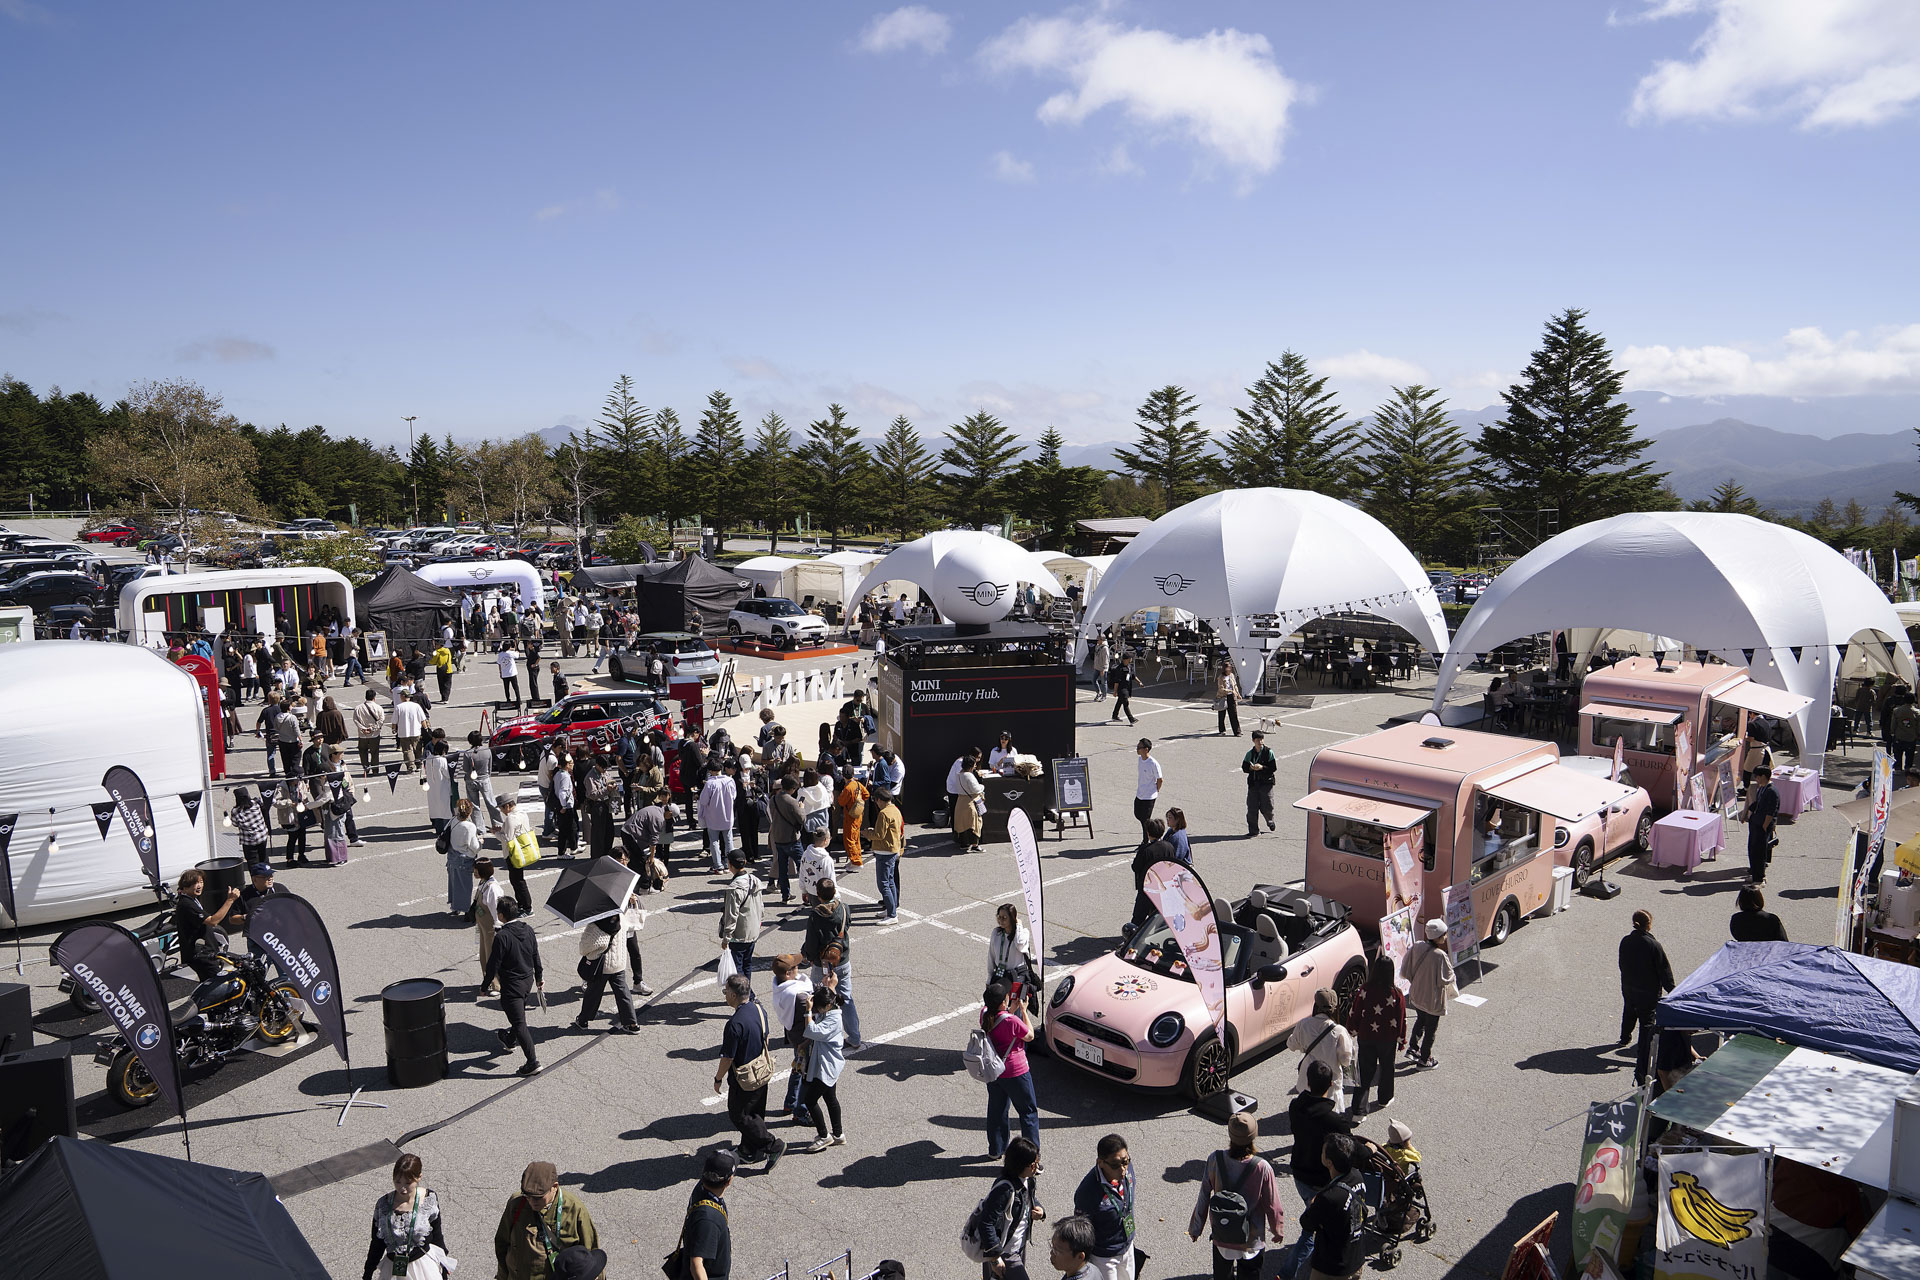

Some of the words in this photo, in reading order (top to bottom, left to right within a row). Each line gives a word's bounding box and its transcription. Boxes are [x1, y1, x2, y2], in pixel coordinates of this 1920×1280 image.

[1067, 547, 1085, 555] トイレ
[976, 590, 996, 598] MINI
[911, 680, 941, 691] MINI
[911, 690, 973, 703] Community
[975, 688, 1000, 700] Hub.
[1627, 757, 1673, 771] CHURRO
[1332, 860, 1364, 878] LOVE
[1481, 883, 1501, 903] LOVE
[1500, 868, 1528, 892] CHURRO
